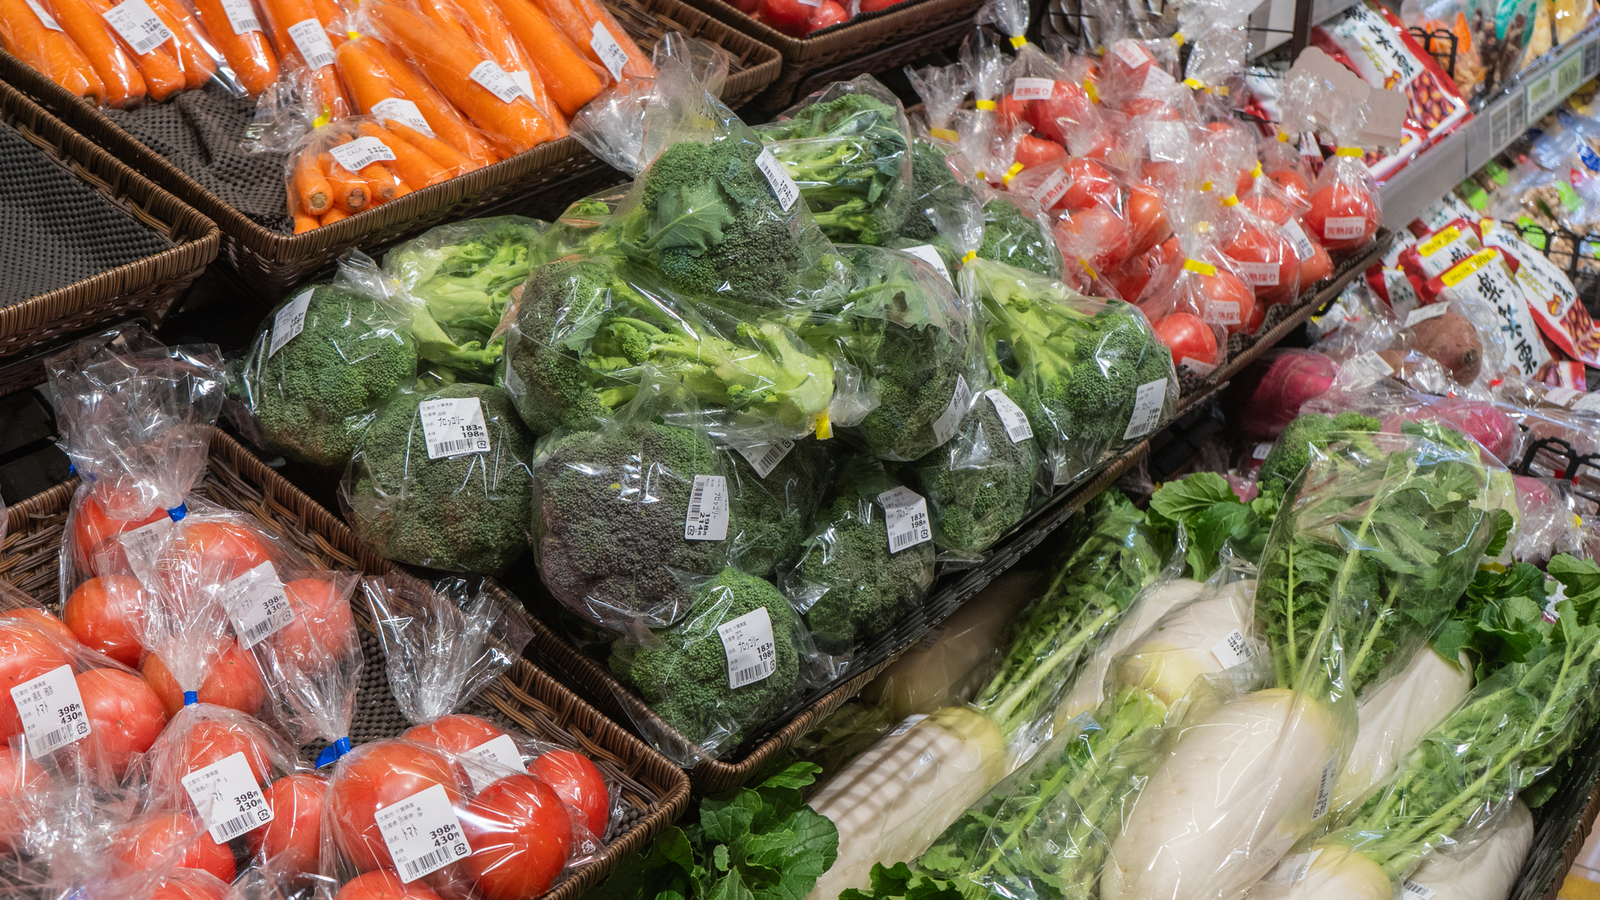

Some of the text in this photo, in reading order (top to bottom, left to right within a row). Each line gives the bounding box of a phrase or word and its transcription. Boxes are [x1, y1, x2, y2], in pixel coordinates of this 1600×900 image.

[140, 18, 156, 29] 137円
[145, 23, 160, 34] 148円
[1039, 175, 1070, 208] 完熟採り
[1325, 226, 1363, 237] 完熟採り
[1248, 272, 1277, 283] 熟採り
[911, 512, 925, 522] 183円
[697, 512, 705, 536] 214円
[703, 513, 711, 536] 198円
[911, 520, 926, 529] 198円
[263, 595, 283, 610] 398円
[265, 602, 287, 615] 430円
[757, 642, 772, 654] 183円
[759, 650, 774, 661] 198円
[35, 701, 48, 716] トマト
[58, 703, 80, 717] 398円
[61, 711, 82, 724] 430円
[234, 791, 258, 805] 398円
[239, 799, 262, 812] 430円
[402, 824, 418, 840] トマト
[430, 824, 456, 840] 398円
[434, 832, 460, 847] 430円
